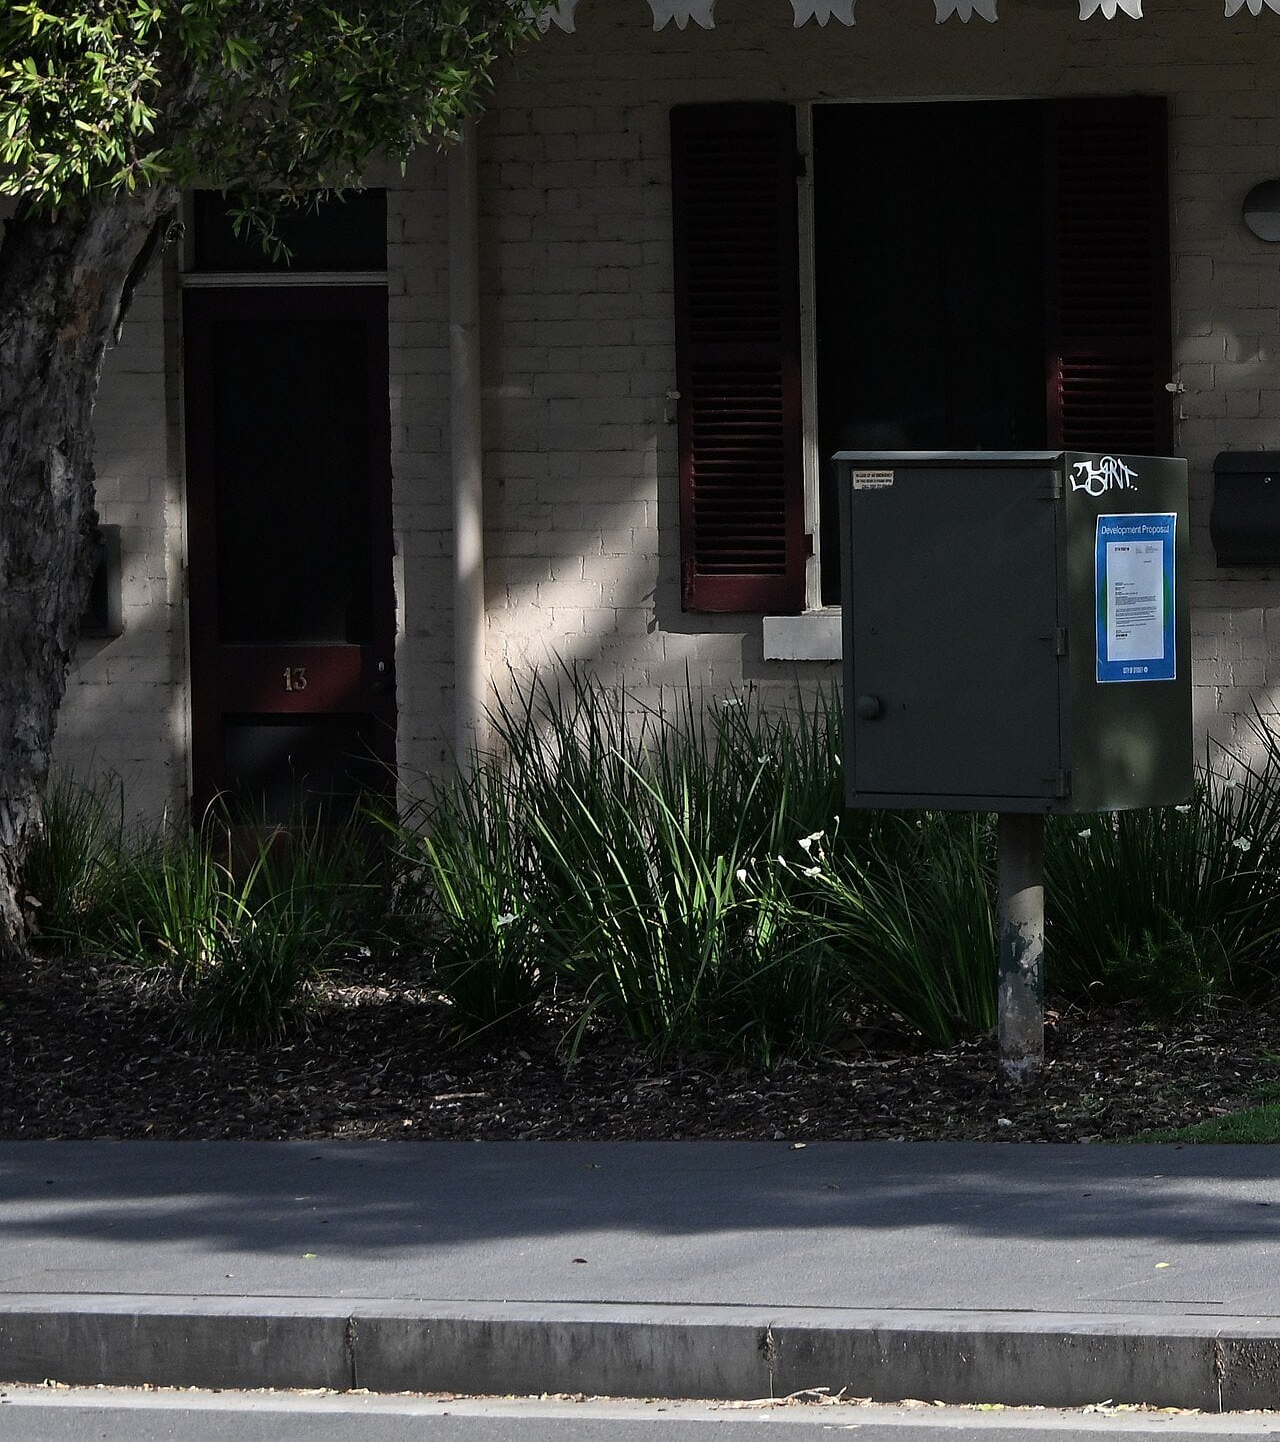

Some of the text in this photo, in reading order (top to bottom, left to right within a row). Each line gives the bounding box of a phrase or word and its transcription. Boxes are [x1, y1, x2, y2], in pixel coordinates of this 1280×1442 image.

[1101, 524, 1170, 536] Development Proposal
[283, 667, 307, 691] 13
